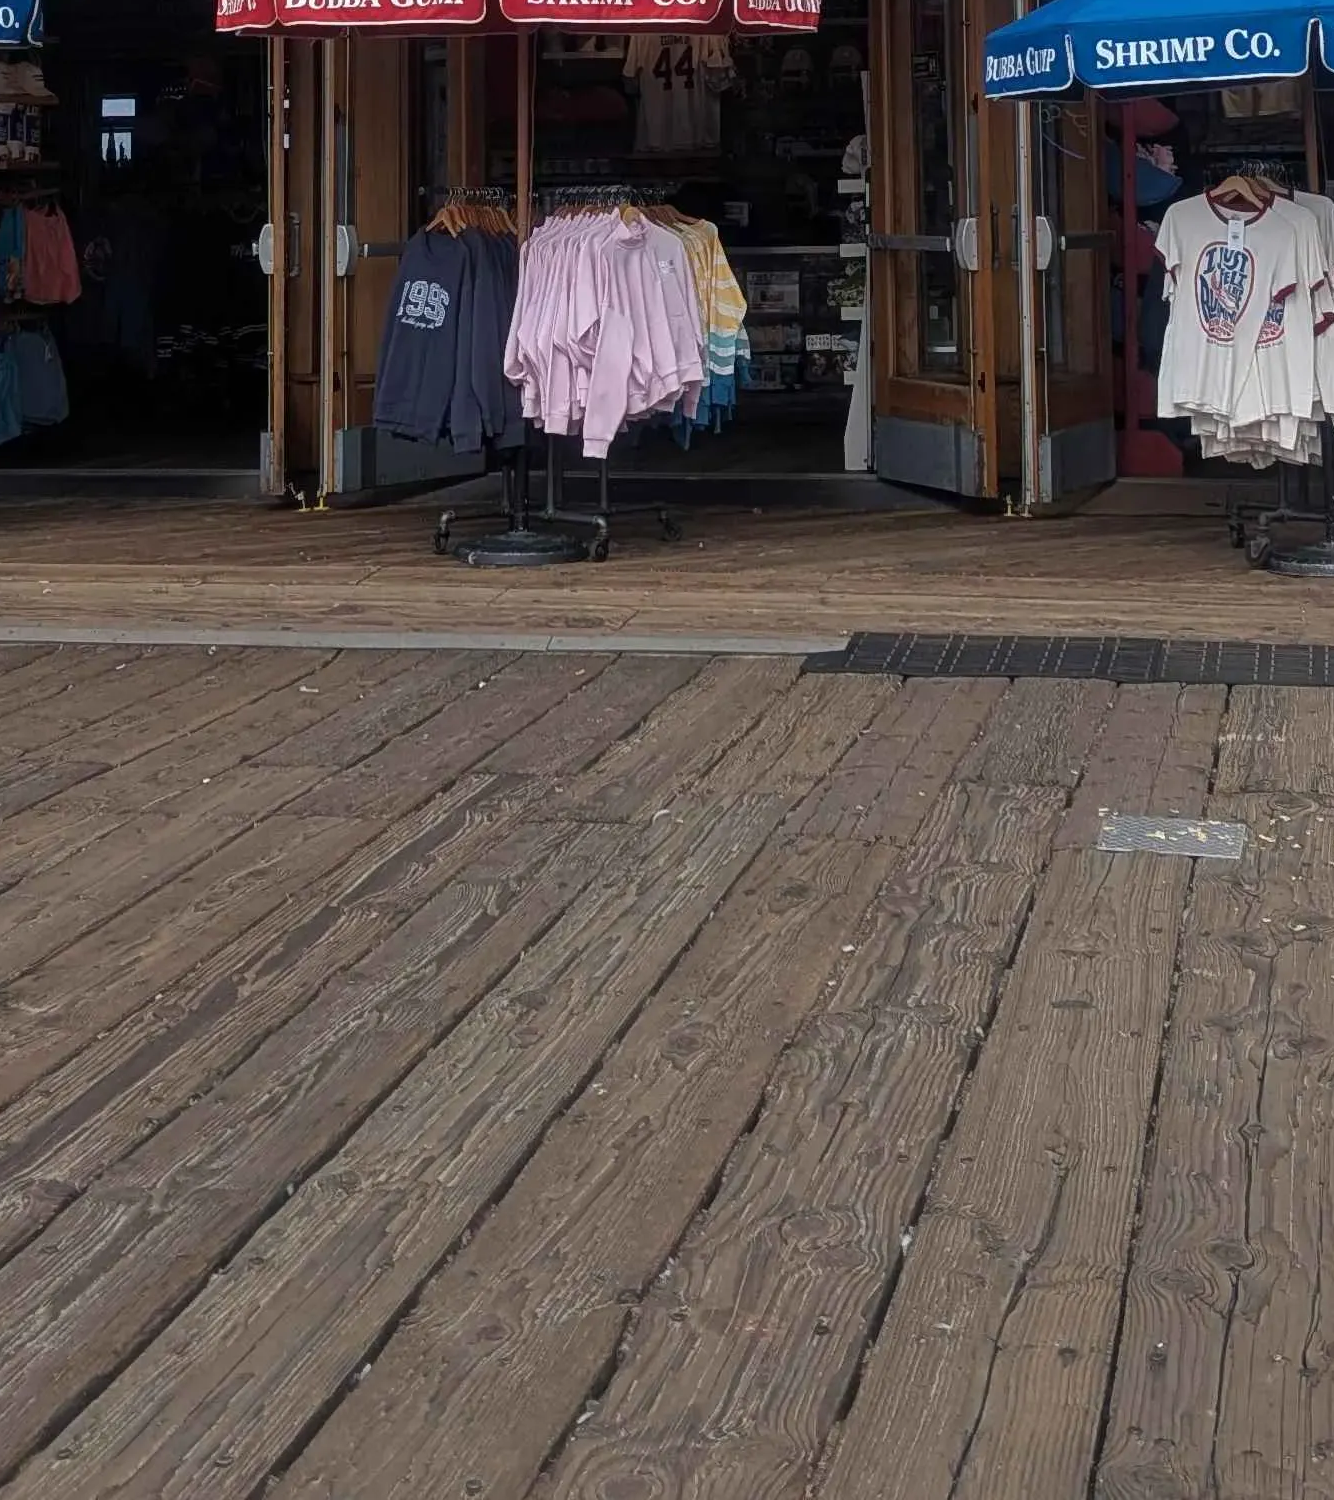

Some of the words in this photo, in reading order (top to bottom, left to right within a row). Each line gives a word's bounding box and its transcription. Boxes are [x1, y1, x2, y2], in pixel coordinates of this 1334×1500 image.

[652, 45, 695, 92] 44
[986, 53, 1025, 83] BUBBA
[1095, 36, 1214, 69] SHRIMP
[1224, 28, 1281, 59] CO.
